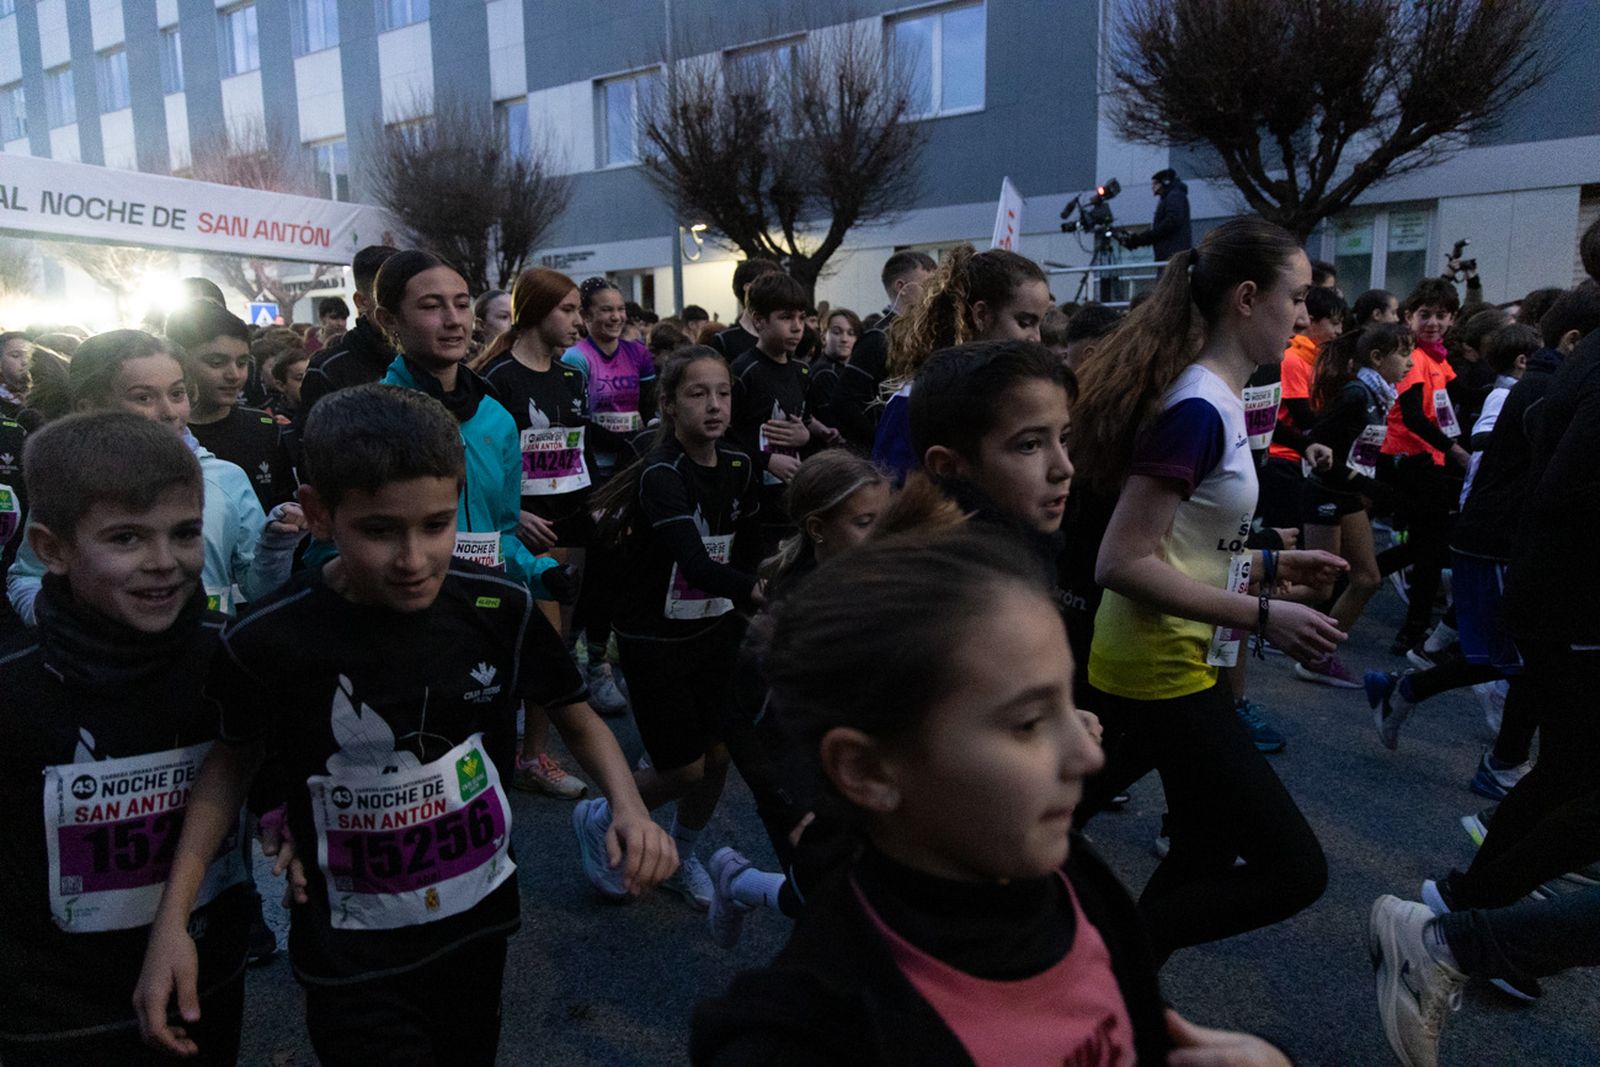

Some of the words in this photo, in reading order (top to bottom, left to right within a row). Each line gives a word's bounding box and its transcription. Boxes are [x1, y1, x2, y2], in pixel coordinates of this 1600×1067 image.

[40, 190, 146, 226] NOCHE
[152, 206, 187, 230] DE
[197, 212, 249, 238] SAN
[253, 219, 331, 248] ANTÓN
[529, 449, 574, 472] 14242
[456, 543, 488, 554] NOCHE
[489, 544, 496, 554] DE
[73, 777, 96, 795] 43
[102, 771, 167, 798] NOCHE
[173, 766, 196, 786] DE
[357, 786, 418, 809] NOCHE
[422, 779, 444, 799] DE
[75, 802, 120, 823] SAN
[338, 813, 375, 830] SAN
[381, 798, 447, 830] ANTÓN
[343, 798, 494, 879] 15256
